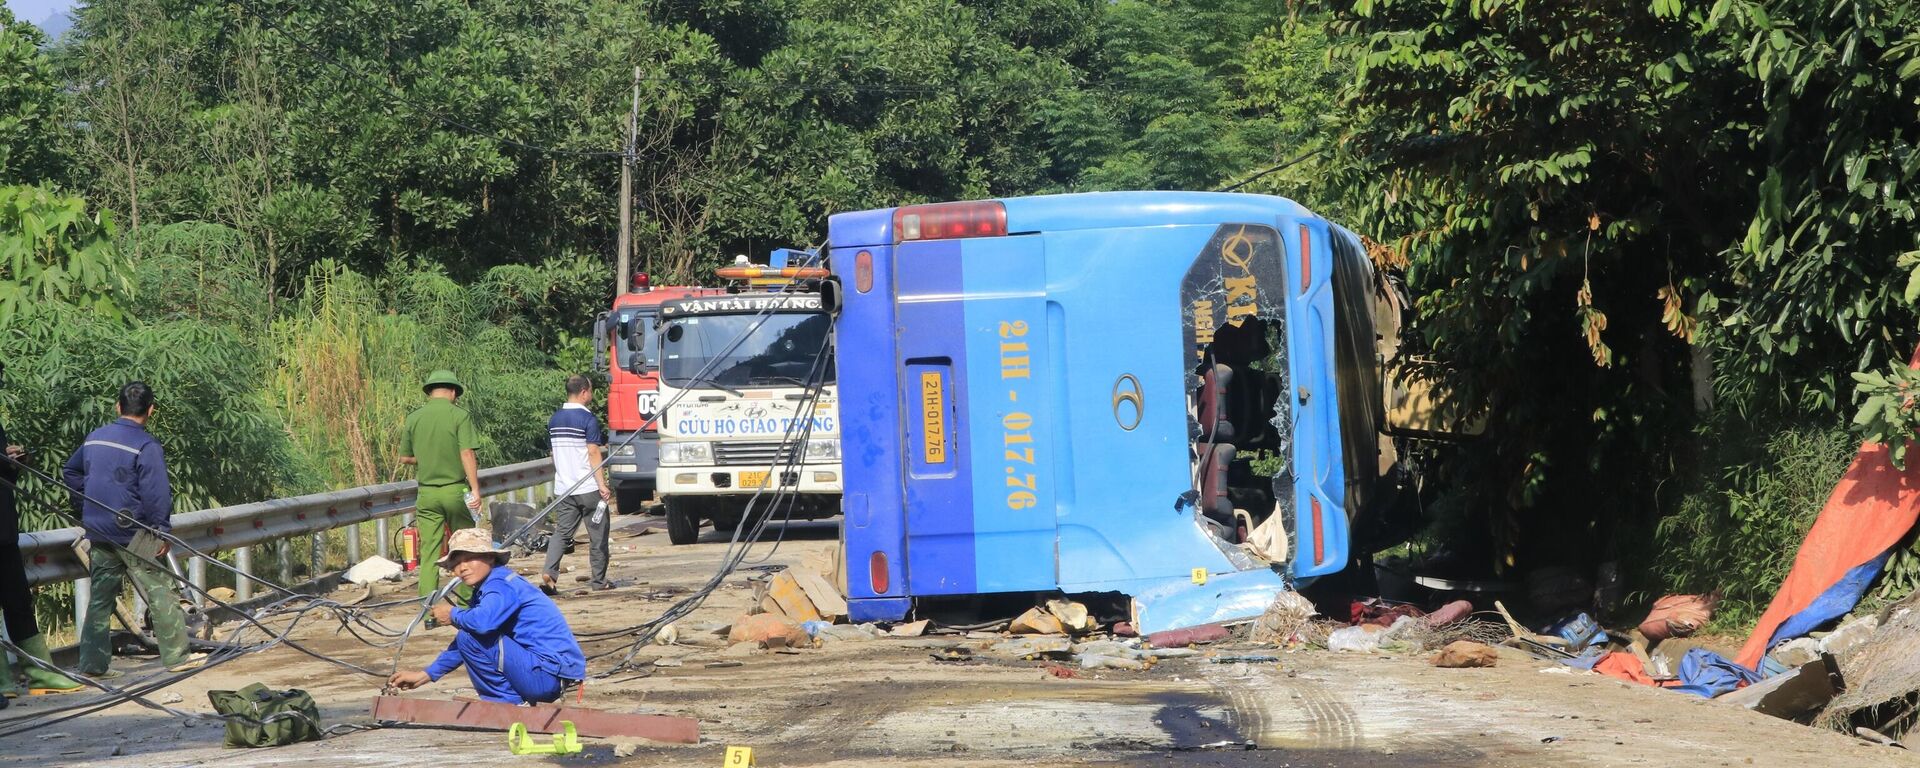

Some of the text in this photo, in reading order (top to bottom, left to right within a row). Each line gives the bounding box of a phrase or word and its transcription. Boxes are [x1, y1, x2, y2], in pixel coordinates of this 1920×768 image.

[793, 299, 823, 310] NG
[1224, 274, 1258, 329] KI
[999, 319, 1031, 379] 21H
[638, 394, 659, 415] 03
[715, 415, 736, 437] HỘ
[739, 418, 777, 434] GIAO
[1002, 411, 1037, 510] 017.76
[1196, 570, 1202, 579] 6
[733, 750, 742, 764] 5
